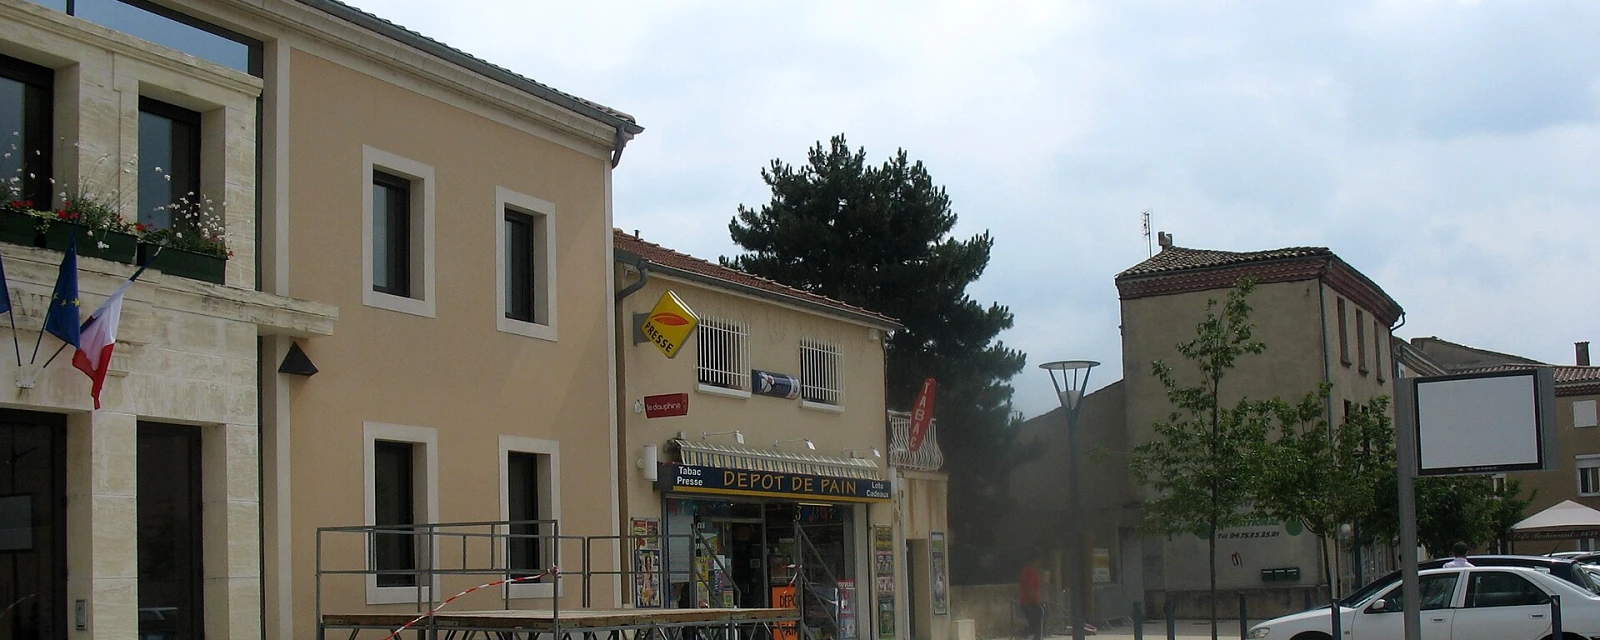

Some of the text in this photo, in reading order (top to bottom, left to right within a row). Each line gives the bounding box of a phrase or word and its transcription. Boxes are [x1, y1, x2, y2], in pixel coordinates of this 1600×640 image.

[644, 321, 674, 353] PRESSE
[910, 382, 930, 448] TABAC
[678, 466, 702, 476] Tabac
[676, 476, 703, 486] Presse
[723, 470, 856, 495] DEPOT DE PAIN
[871, 482, 884, 490] Loto
[866, 489, 889, 498] Cadeaux
